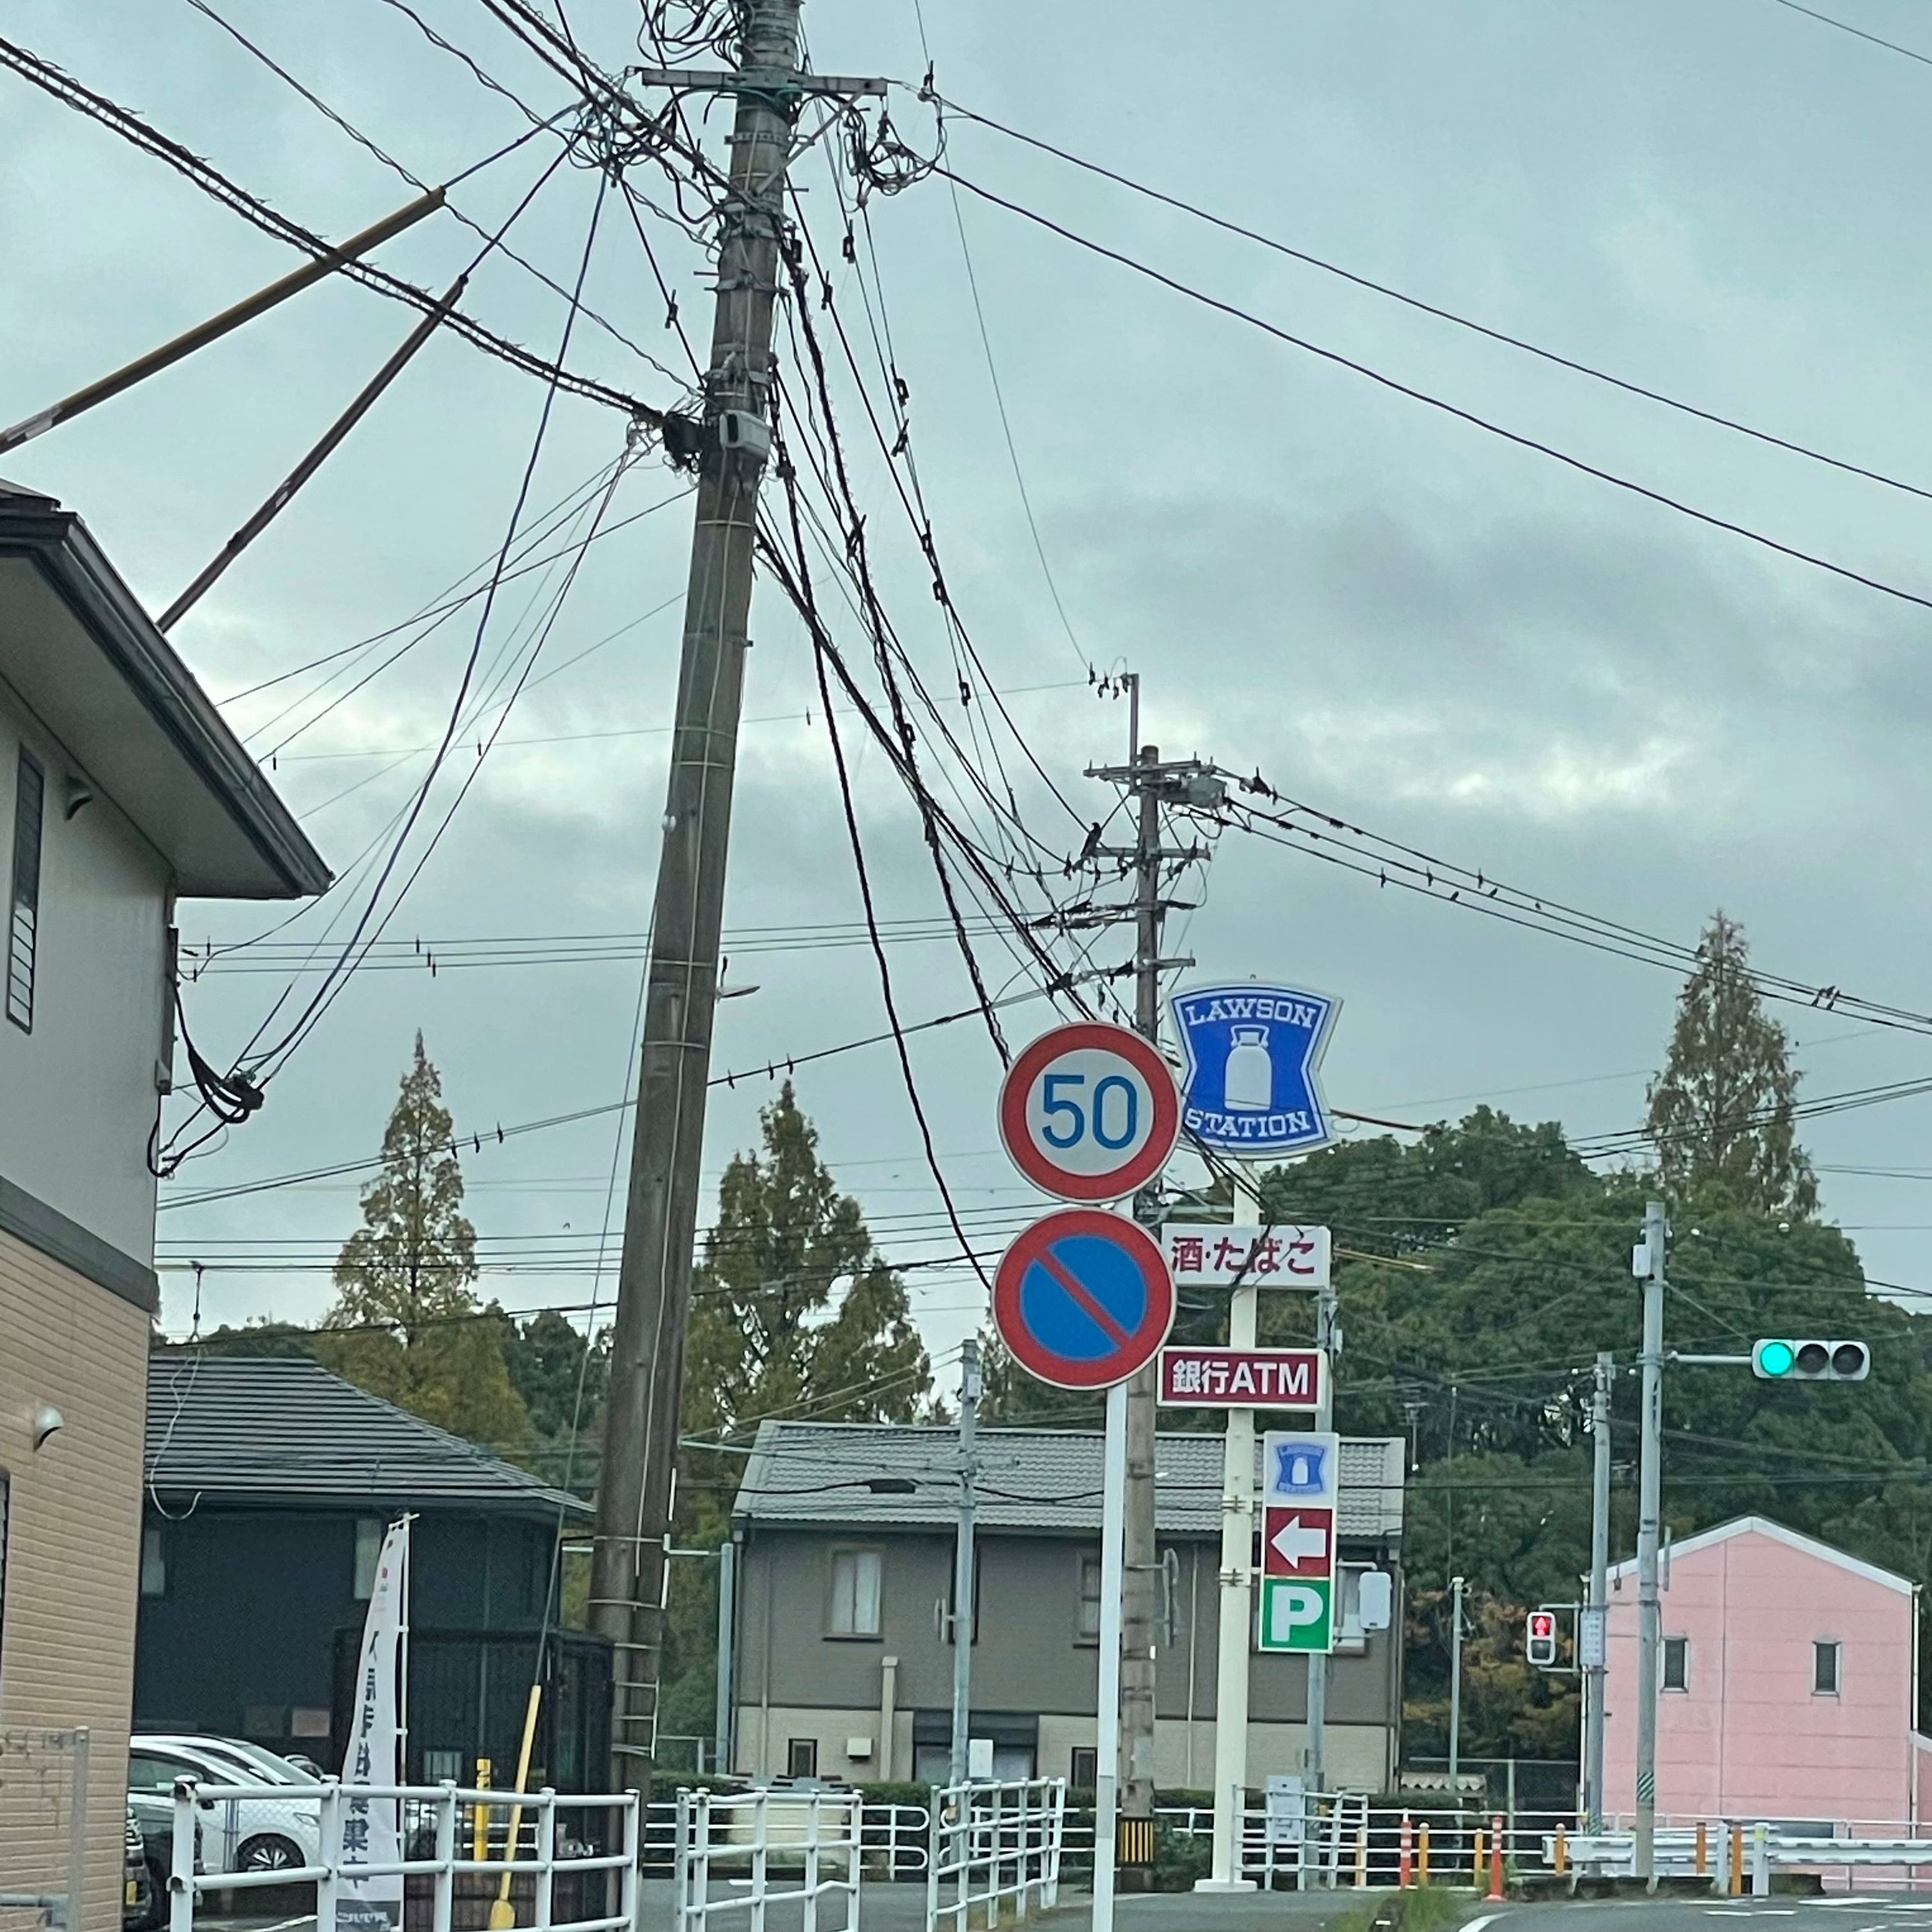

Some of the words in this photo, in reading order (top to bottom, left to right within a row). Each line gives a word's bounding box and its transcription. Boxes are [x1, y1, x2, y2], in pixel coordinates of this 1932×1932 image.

[1185, 999, 1316, 1028] LAWSON
[1042, 1075, 1137, 1149] 50
[1184, 1108, 1310, 1137] STATION
[1172, 1236, 1315, 1274] 酒・たばこ
[1172, 1359, 1309, 1396] 銀行ATM
[1270, 1586, 1324, 1643] P
